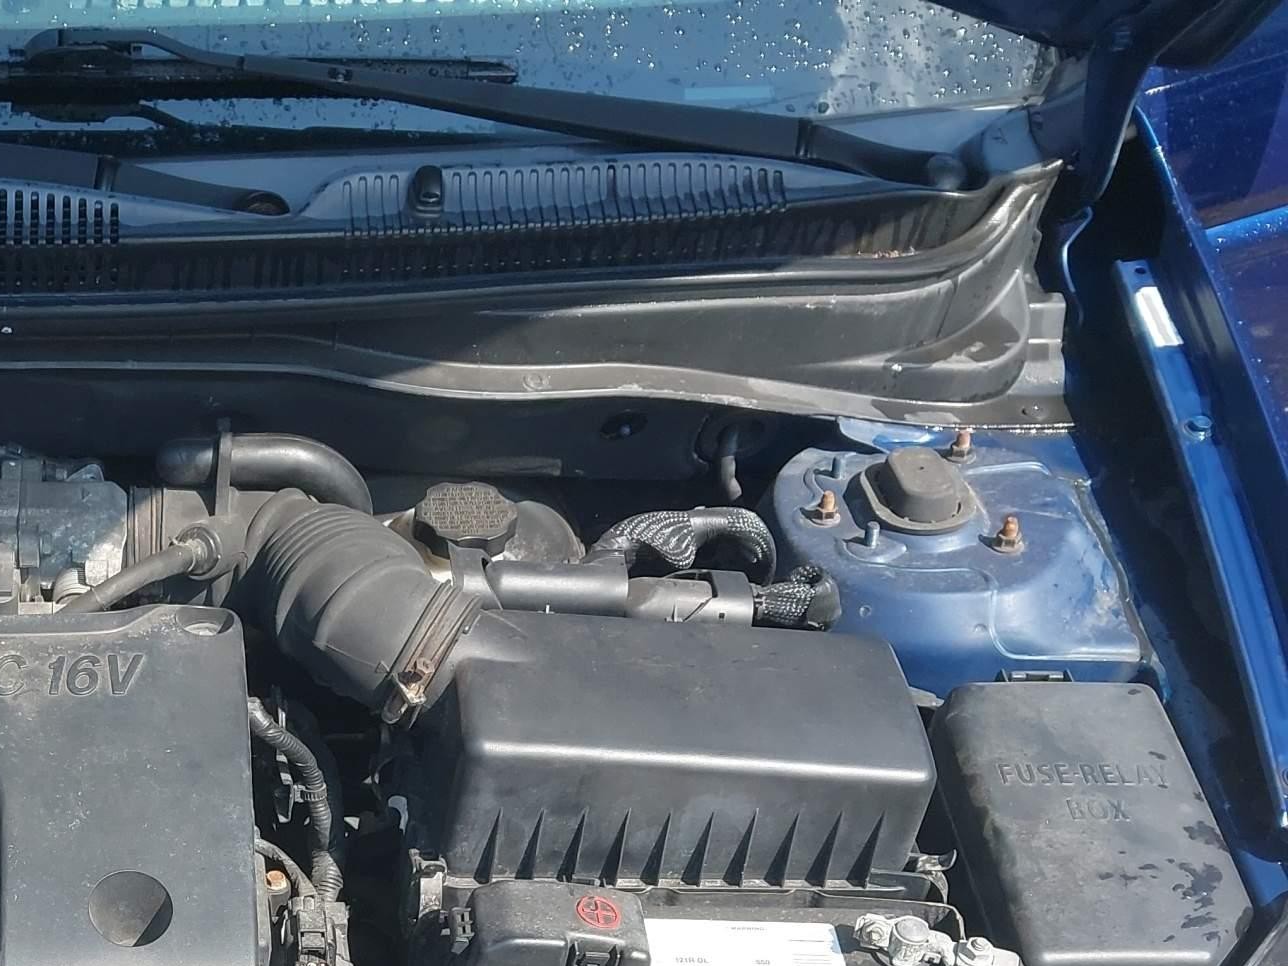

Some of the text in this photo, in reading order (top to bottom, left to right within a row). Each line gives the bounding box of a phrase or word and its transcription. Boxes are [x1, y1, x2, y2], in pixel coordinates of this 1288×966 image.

[48, 654, 144, 696] 16V
[996, 762, 1169, 786] FUSE-RELAY
[1066, 798, 1130, 821] BOX
